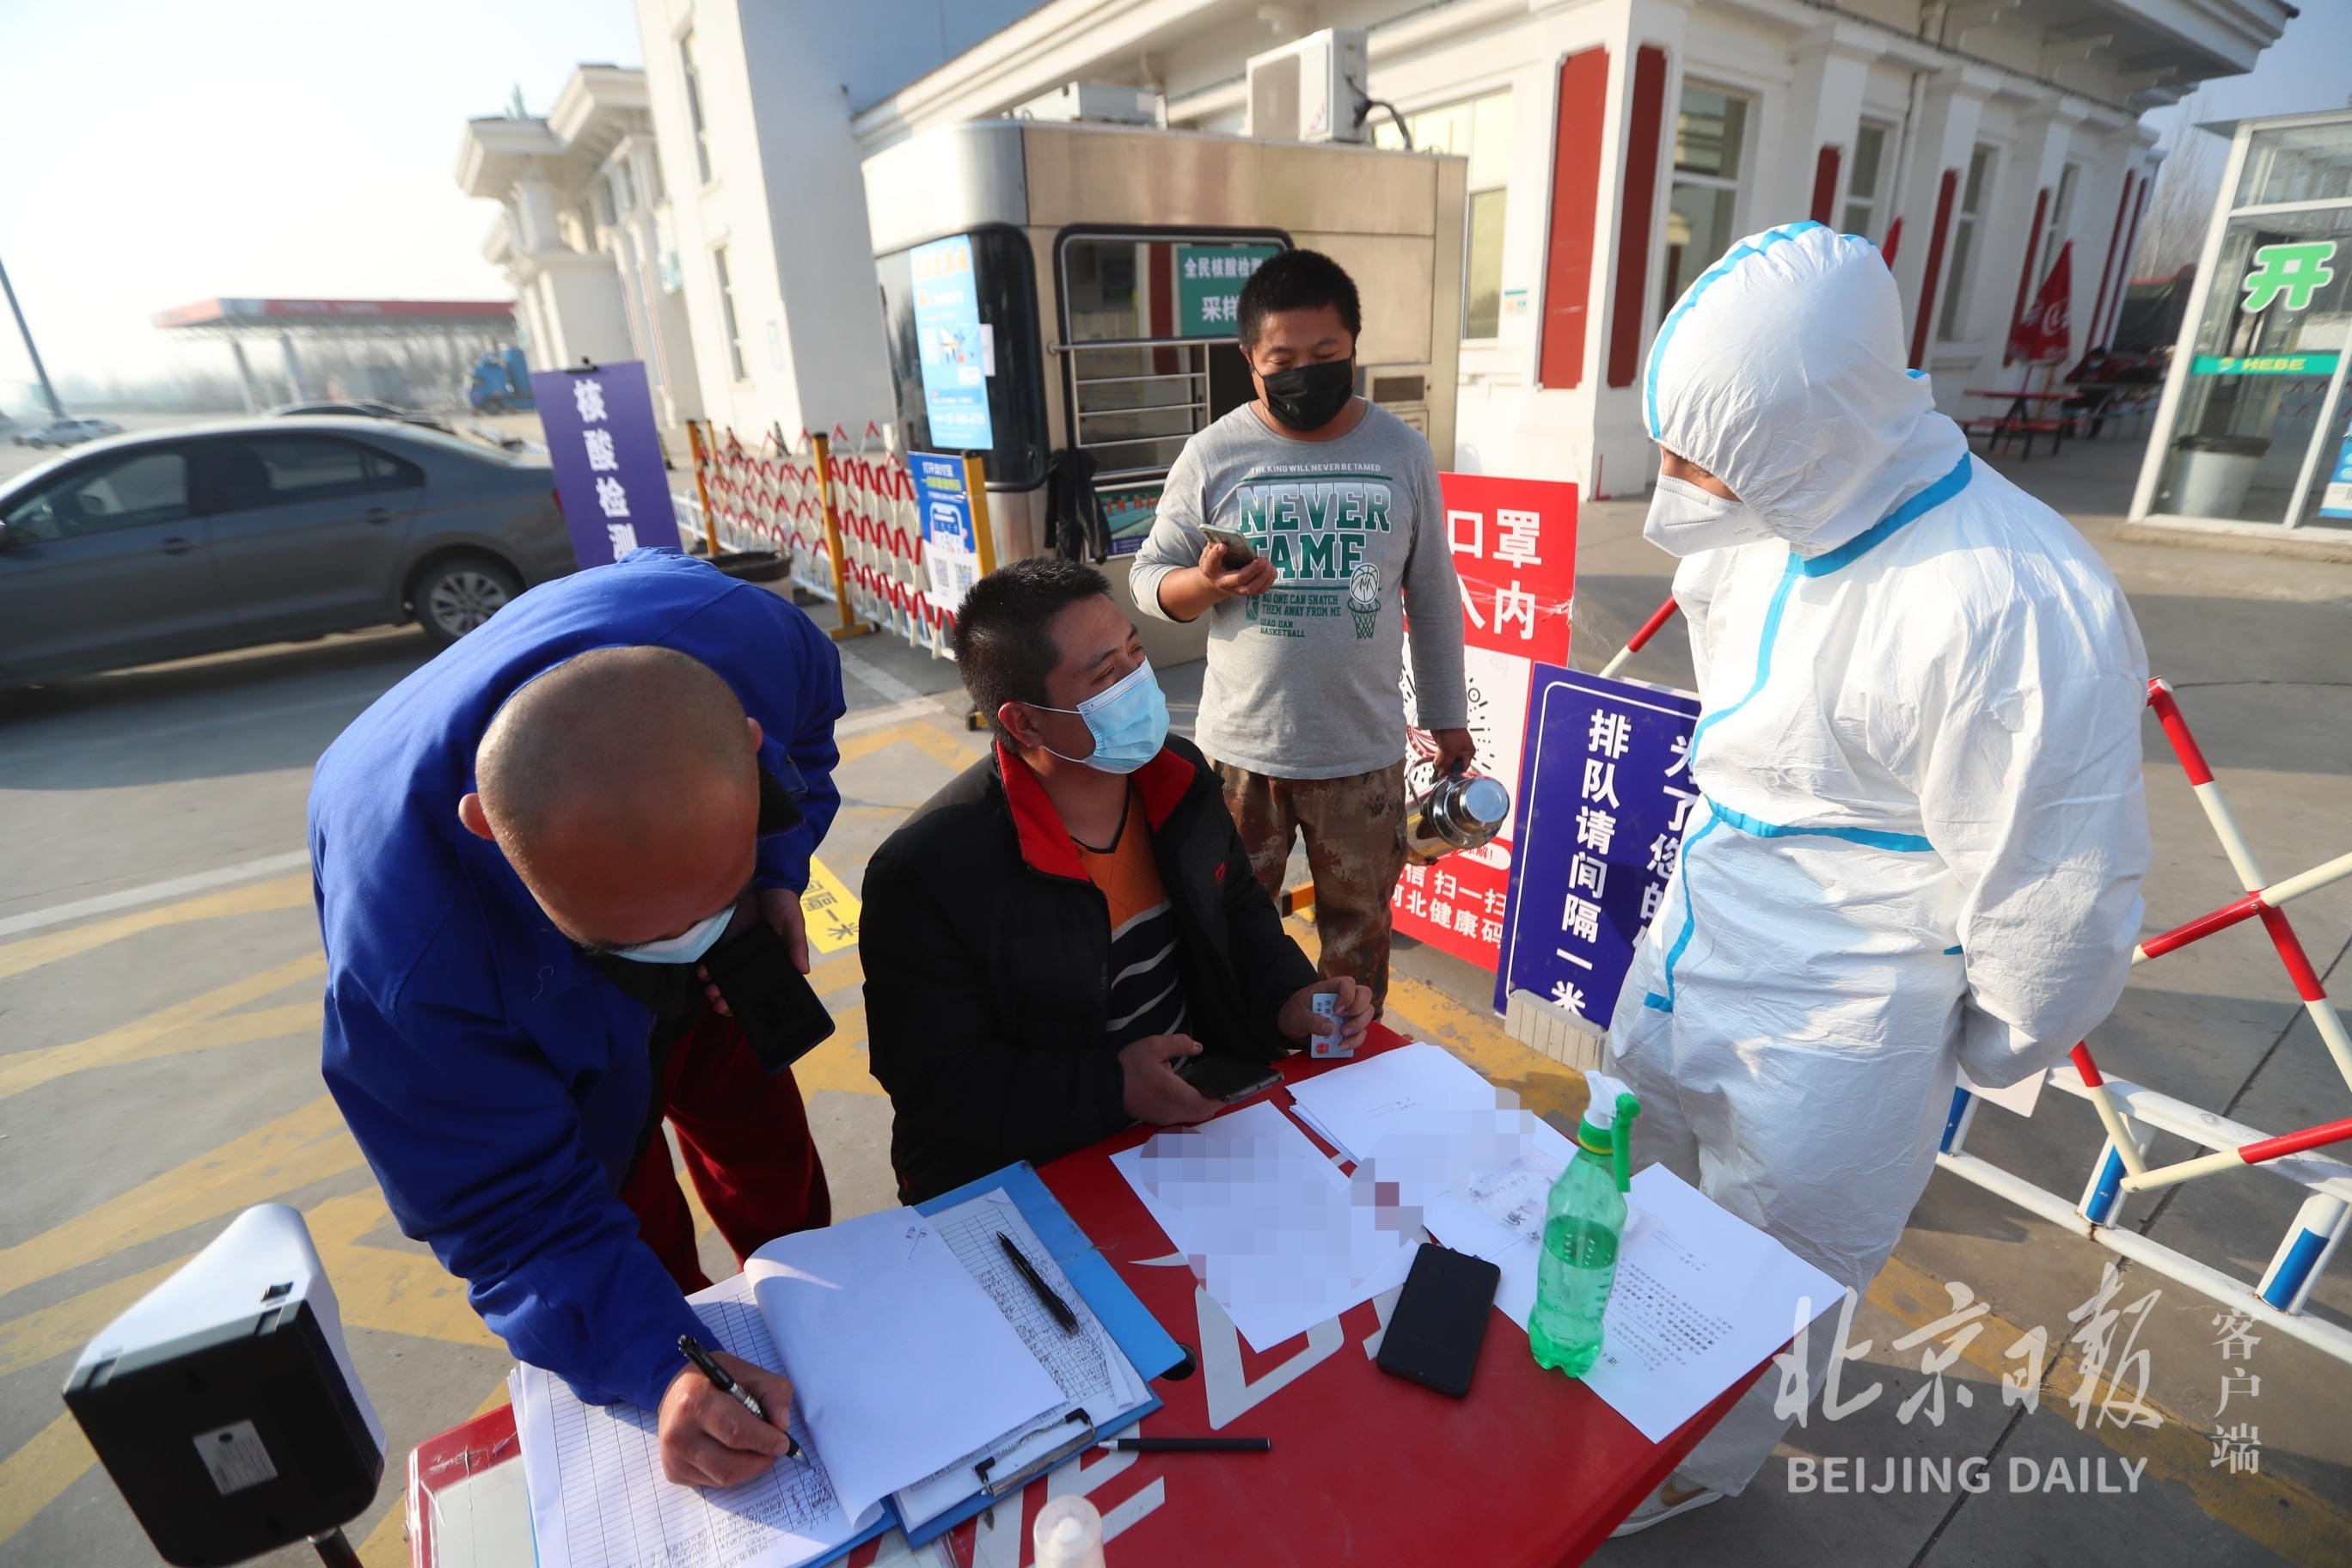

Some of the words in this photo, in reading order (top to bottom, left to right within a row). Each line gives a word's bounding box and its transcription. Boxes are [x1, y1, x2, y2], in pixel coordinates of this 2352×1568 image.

[2240, 241, 2337, 313] 开
[573, 378, 640, 561] 核酸检测
[1267, 464, 1288, 473] KING
[1353, 462, 1381, 471] TAMED
[1236, 481, 1391, 534] NEVER
[1447, 508, 1542, 569] 口罩
[1261, 603, 1282, 616] THEM
[1283, 604, 1305, 616] AWAY
[1306, 606, 1328, 617] FROM
[1330, 607, 1342, 617] ME
[1273, 594, 1289, 603] ONE
[1290, 594, 1307, 604] CAN
[1308, 595, 1338, 605] SNATCH
[1260, 627, 1306, 638] BASKETBALL
[1550, 708, 1632, 1018] 排队请间隔一米
[1434, 869, 1507, 918] 扫一扫
